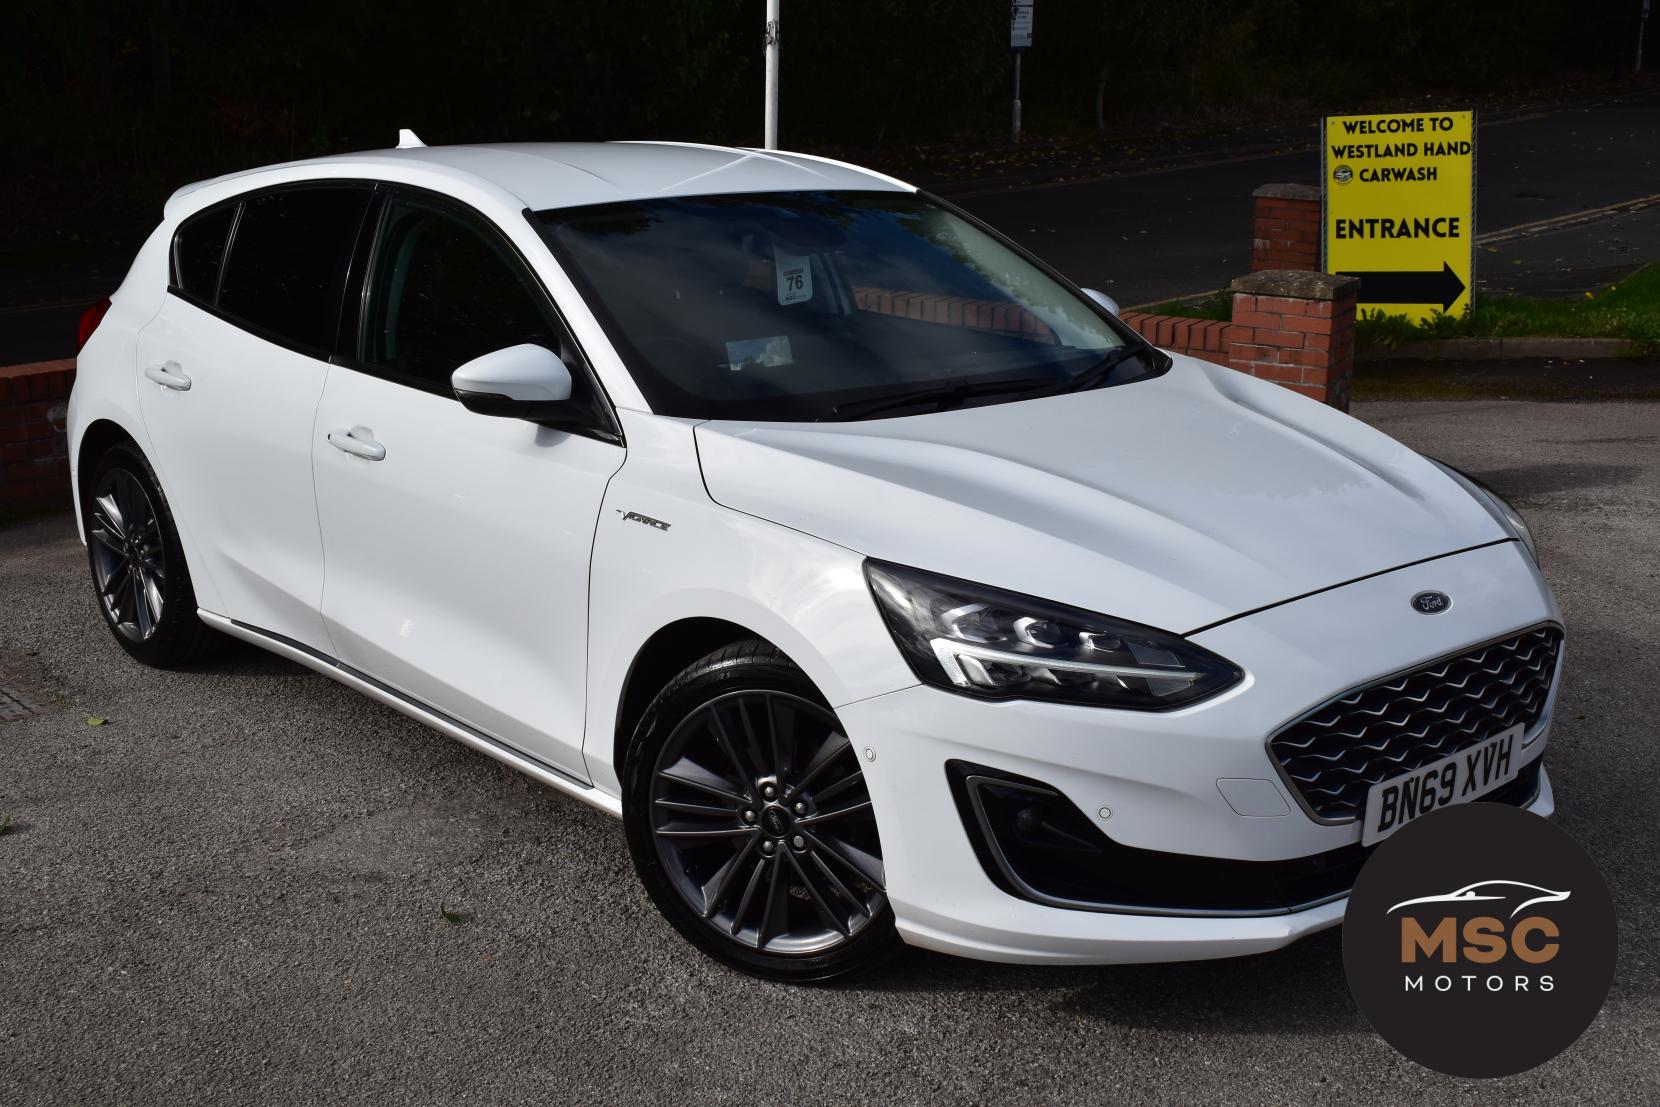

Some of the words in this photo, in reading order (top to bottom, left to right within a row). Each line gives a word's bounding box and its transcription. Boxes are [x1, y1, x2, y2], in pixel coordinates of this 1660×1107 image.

[1342, 118, 1424, 134] WELCOME
[1430, 117, 1454, 131] TO
[1331, 143, 1418, 158] WESTLAND
[1424, 142, 1471, 156] HAND
[1359, 167, 1437, 182] CARWASH
[1336, 218, 1459, 239] ENTRANCE
[786, 275, 803, 291] 76
[1419, 595, 1444, 611] Ford
[1377, 761, 1457, 833] BN69
[1462, 734, 1514, 797] XVH
